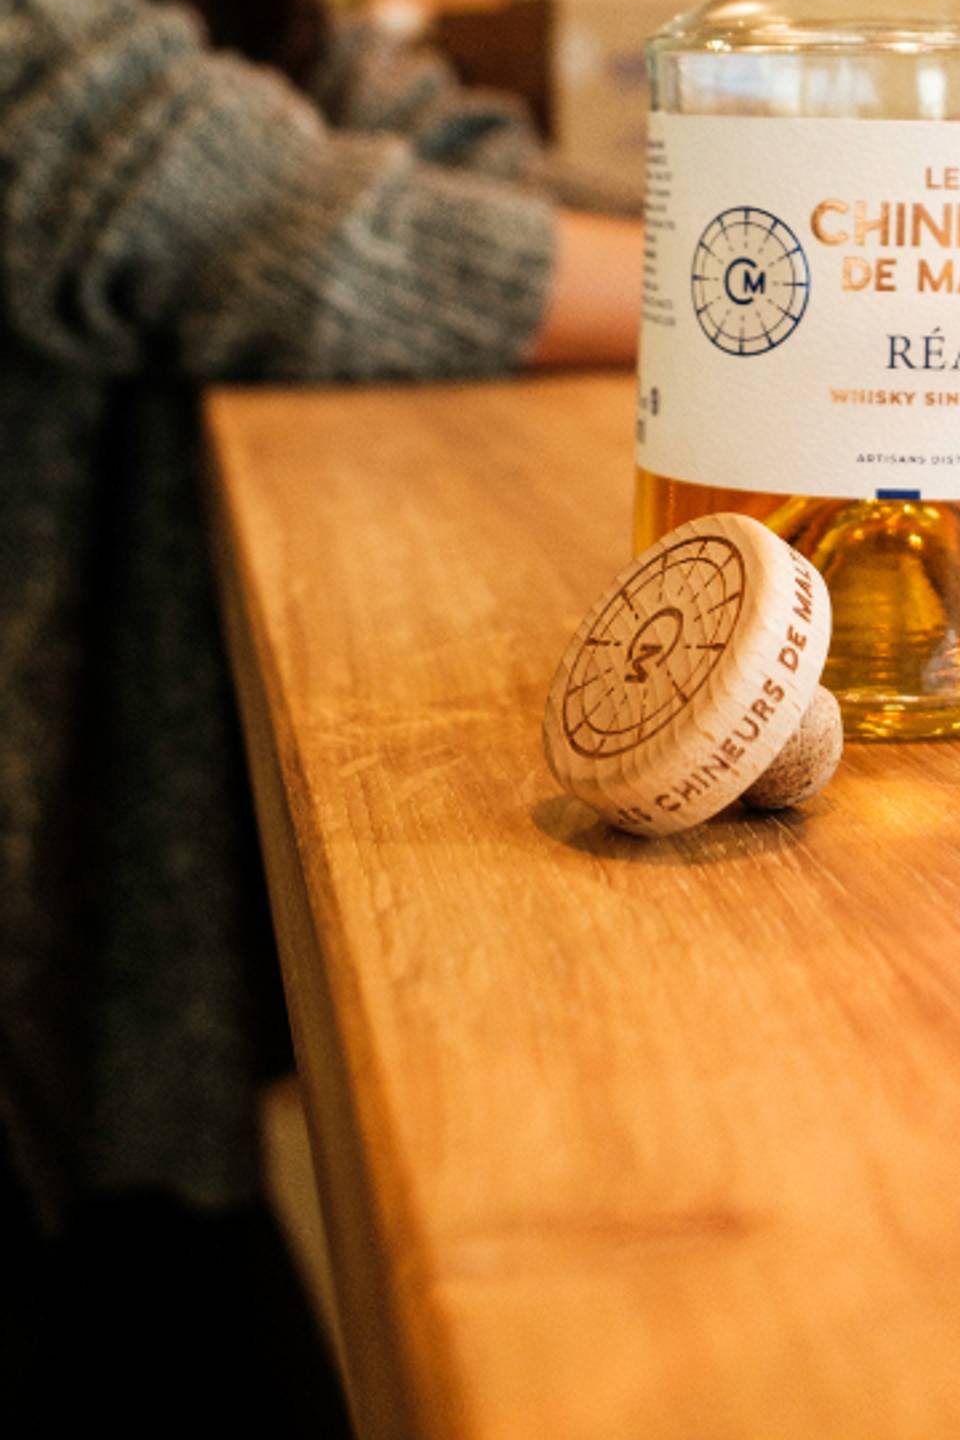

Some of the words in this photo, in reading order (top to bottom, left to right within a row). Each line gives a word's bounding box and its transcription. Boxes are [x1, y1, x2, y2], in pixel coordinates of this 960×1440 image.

[842, 256, 897, 292] DE
[830, 388, 917, 407] WHISKY
[655, 679, 785, 812] CHINEURS
[778, 623, 807, 673] DE
